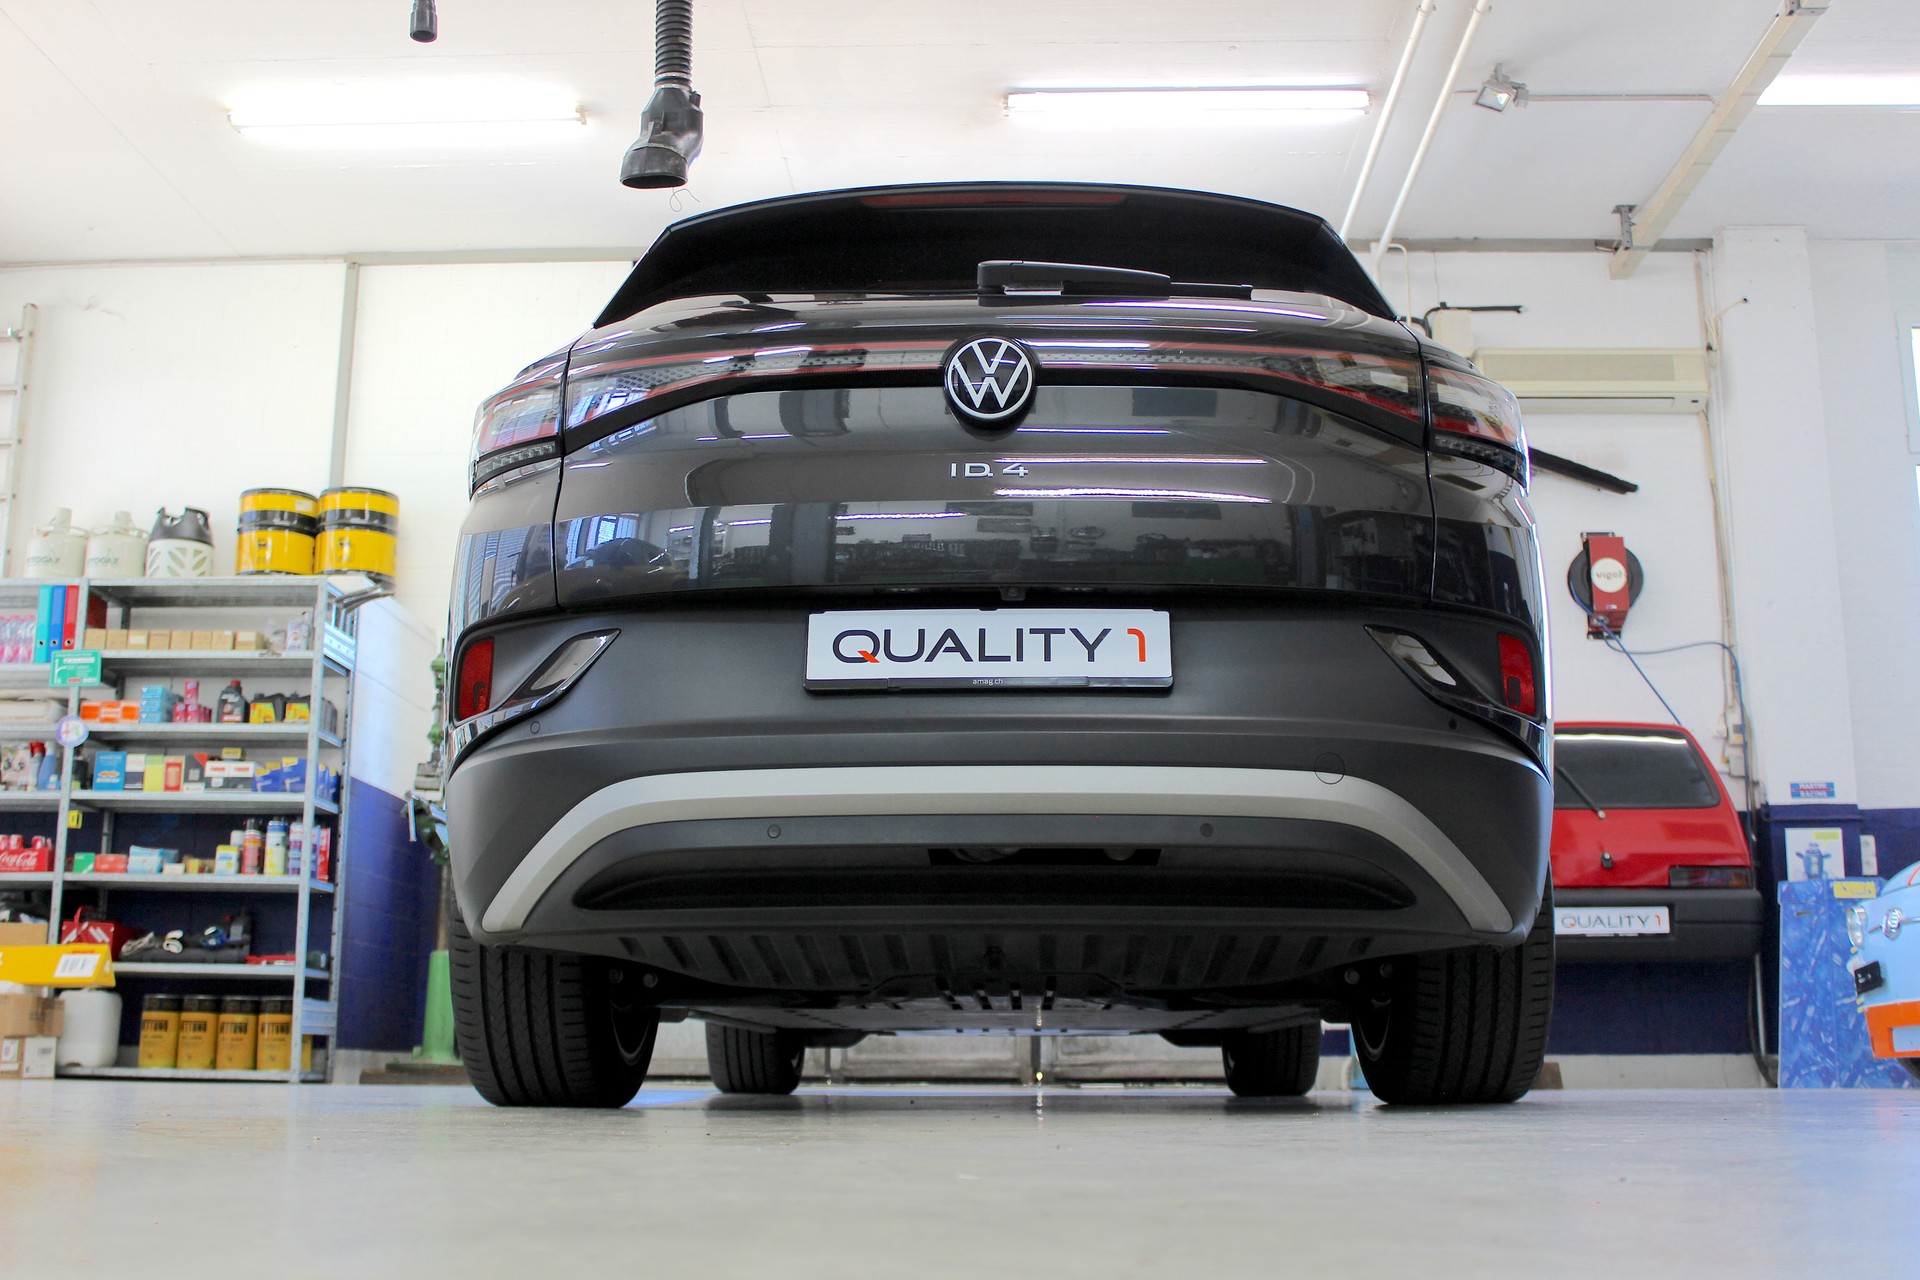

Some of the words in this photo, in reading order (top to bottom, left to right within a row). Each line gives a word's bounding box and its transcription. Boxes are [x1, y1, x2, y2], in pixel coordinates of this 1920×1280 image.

[832, 628, 1112, 663] QUALITY
[1127, 628, 1146, 662] 1
[972, 678, 1004, 686] amag.ch
[1561, 915, 1650, 928] QUALITY
[1654, 914, 1662, 927] 1
